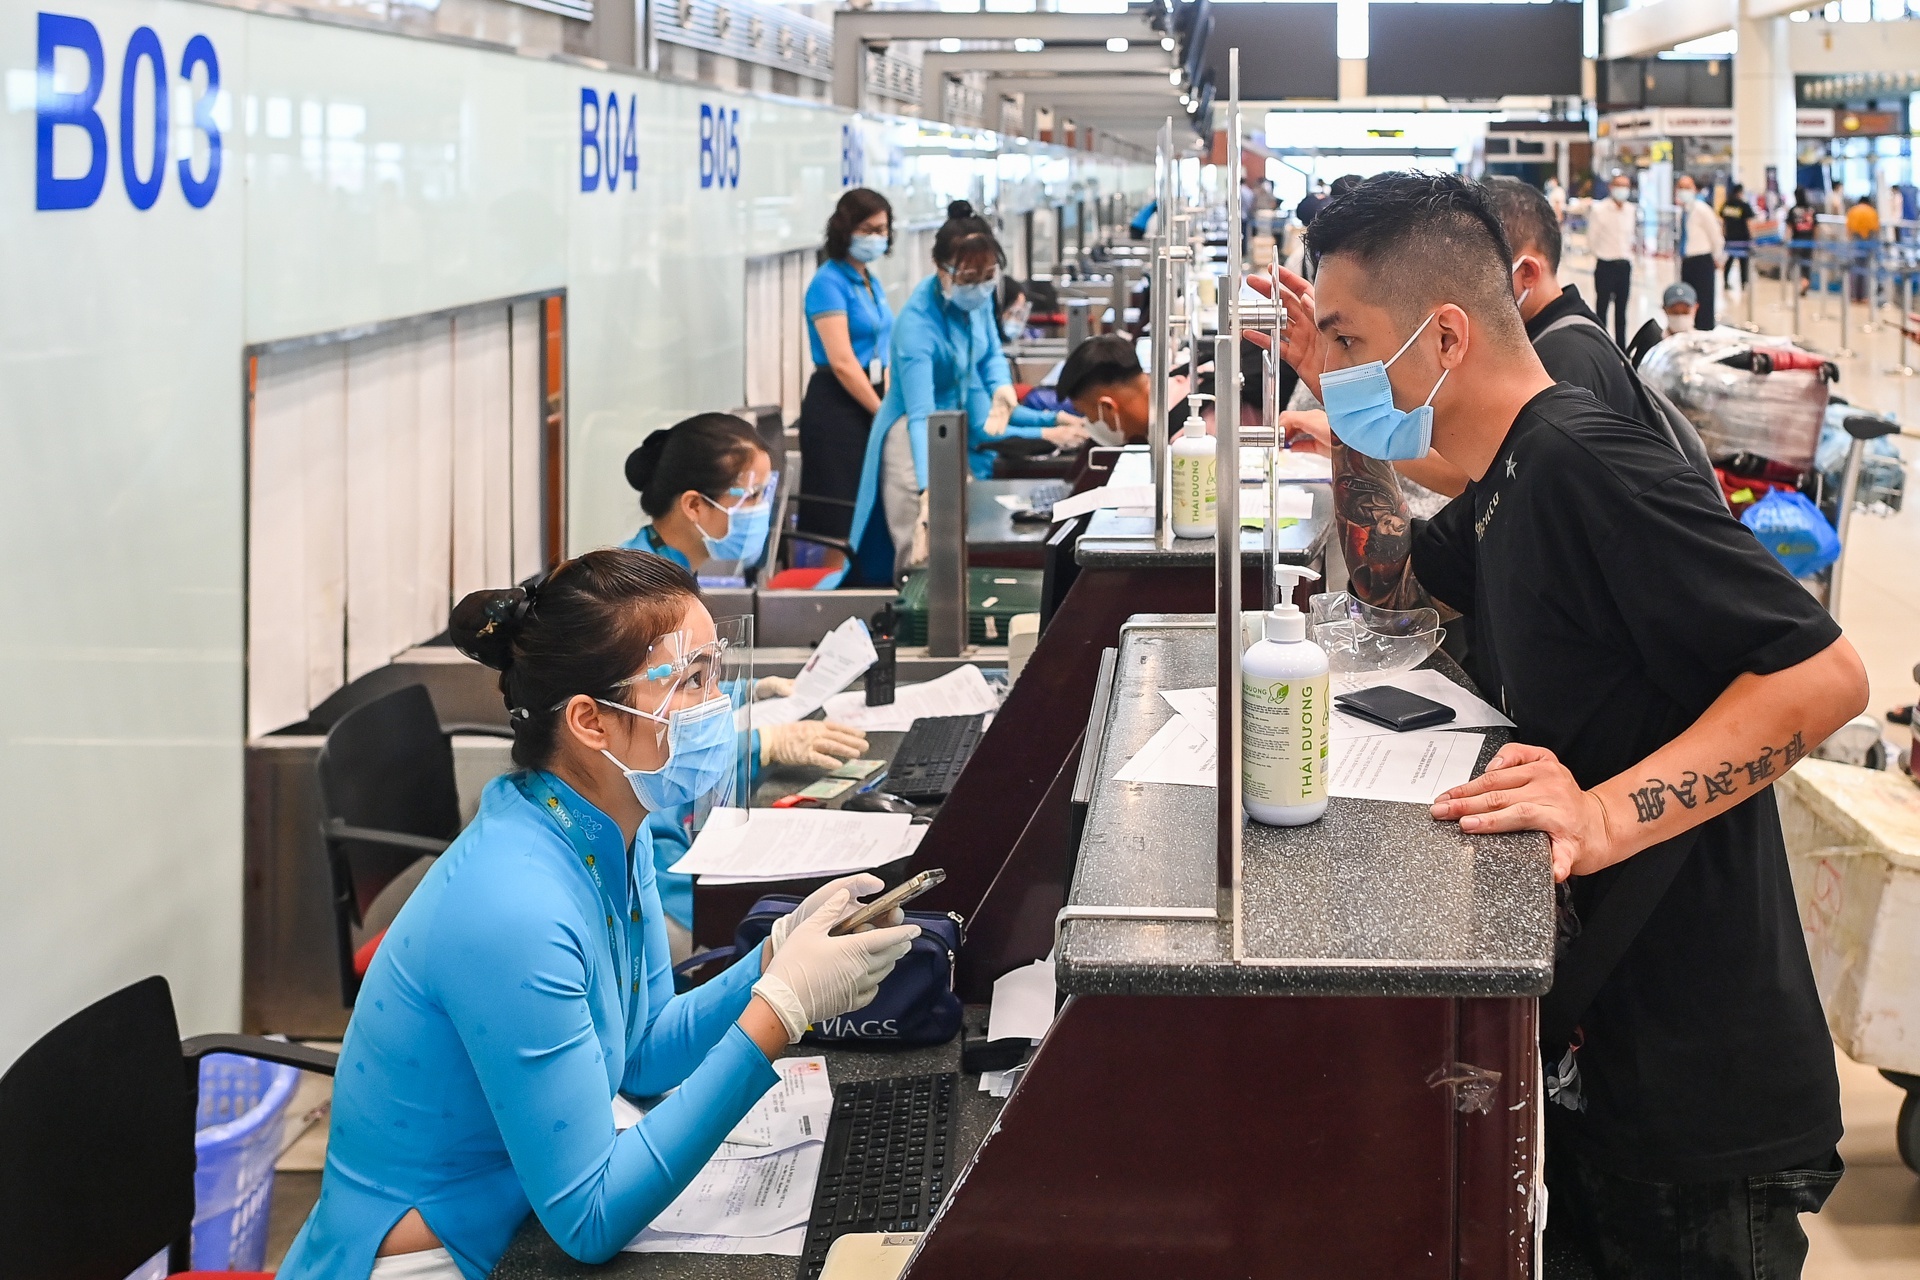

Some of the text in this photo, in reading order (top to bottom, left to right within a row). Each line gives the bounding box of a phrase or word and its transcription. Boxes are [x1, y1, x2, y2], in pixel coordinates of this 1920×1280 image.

[35, 12, 221, 212] B03
[580, 87, 638, 193] B04
[700, 104, 740, 189] B05
[1299, 686, 1313, 798] THÁI DƯƠNG
[556, 806, 573, 828] VIAGS
[821, 1017, 898, 1037] VIAGS
